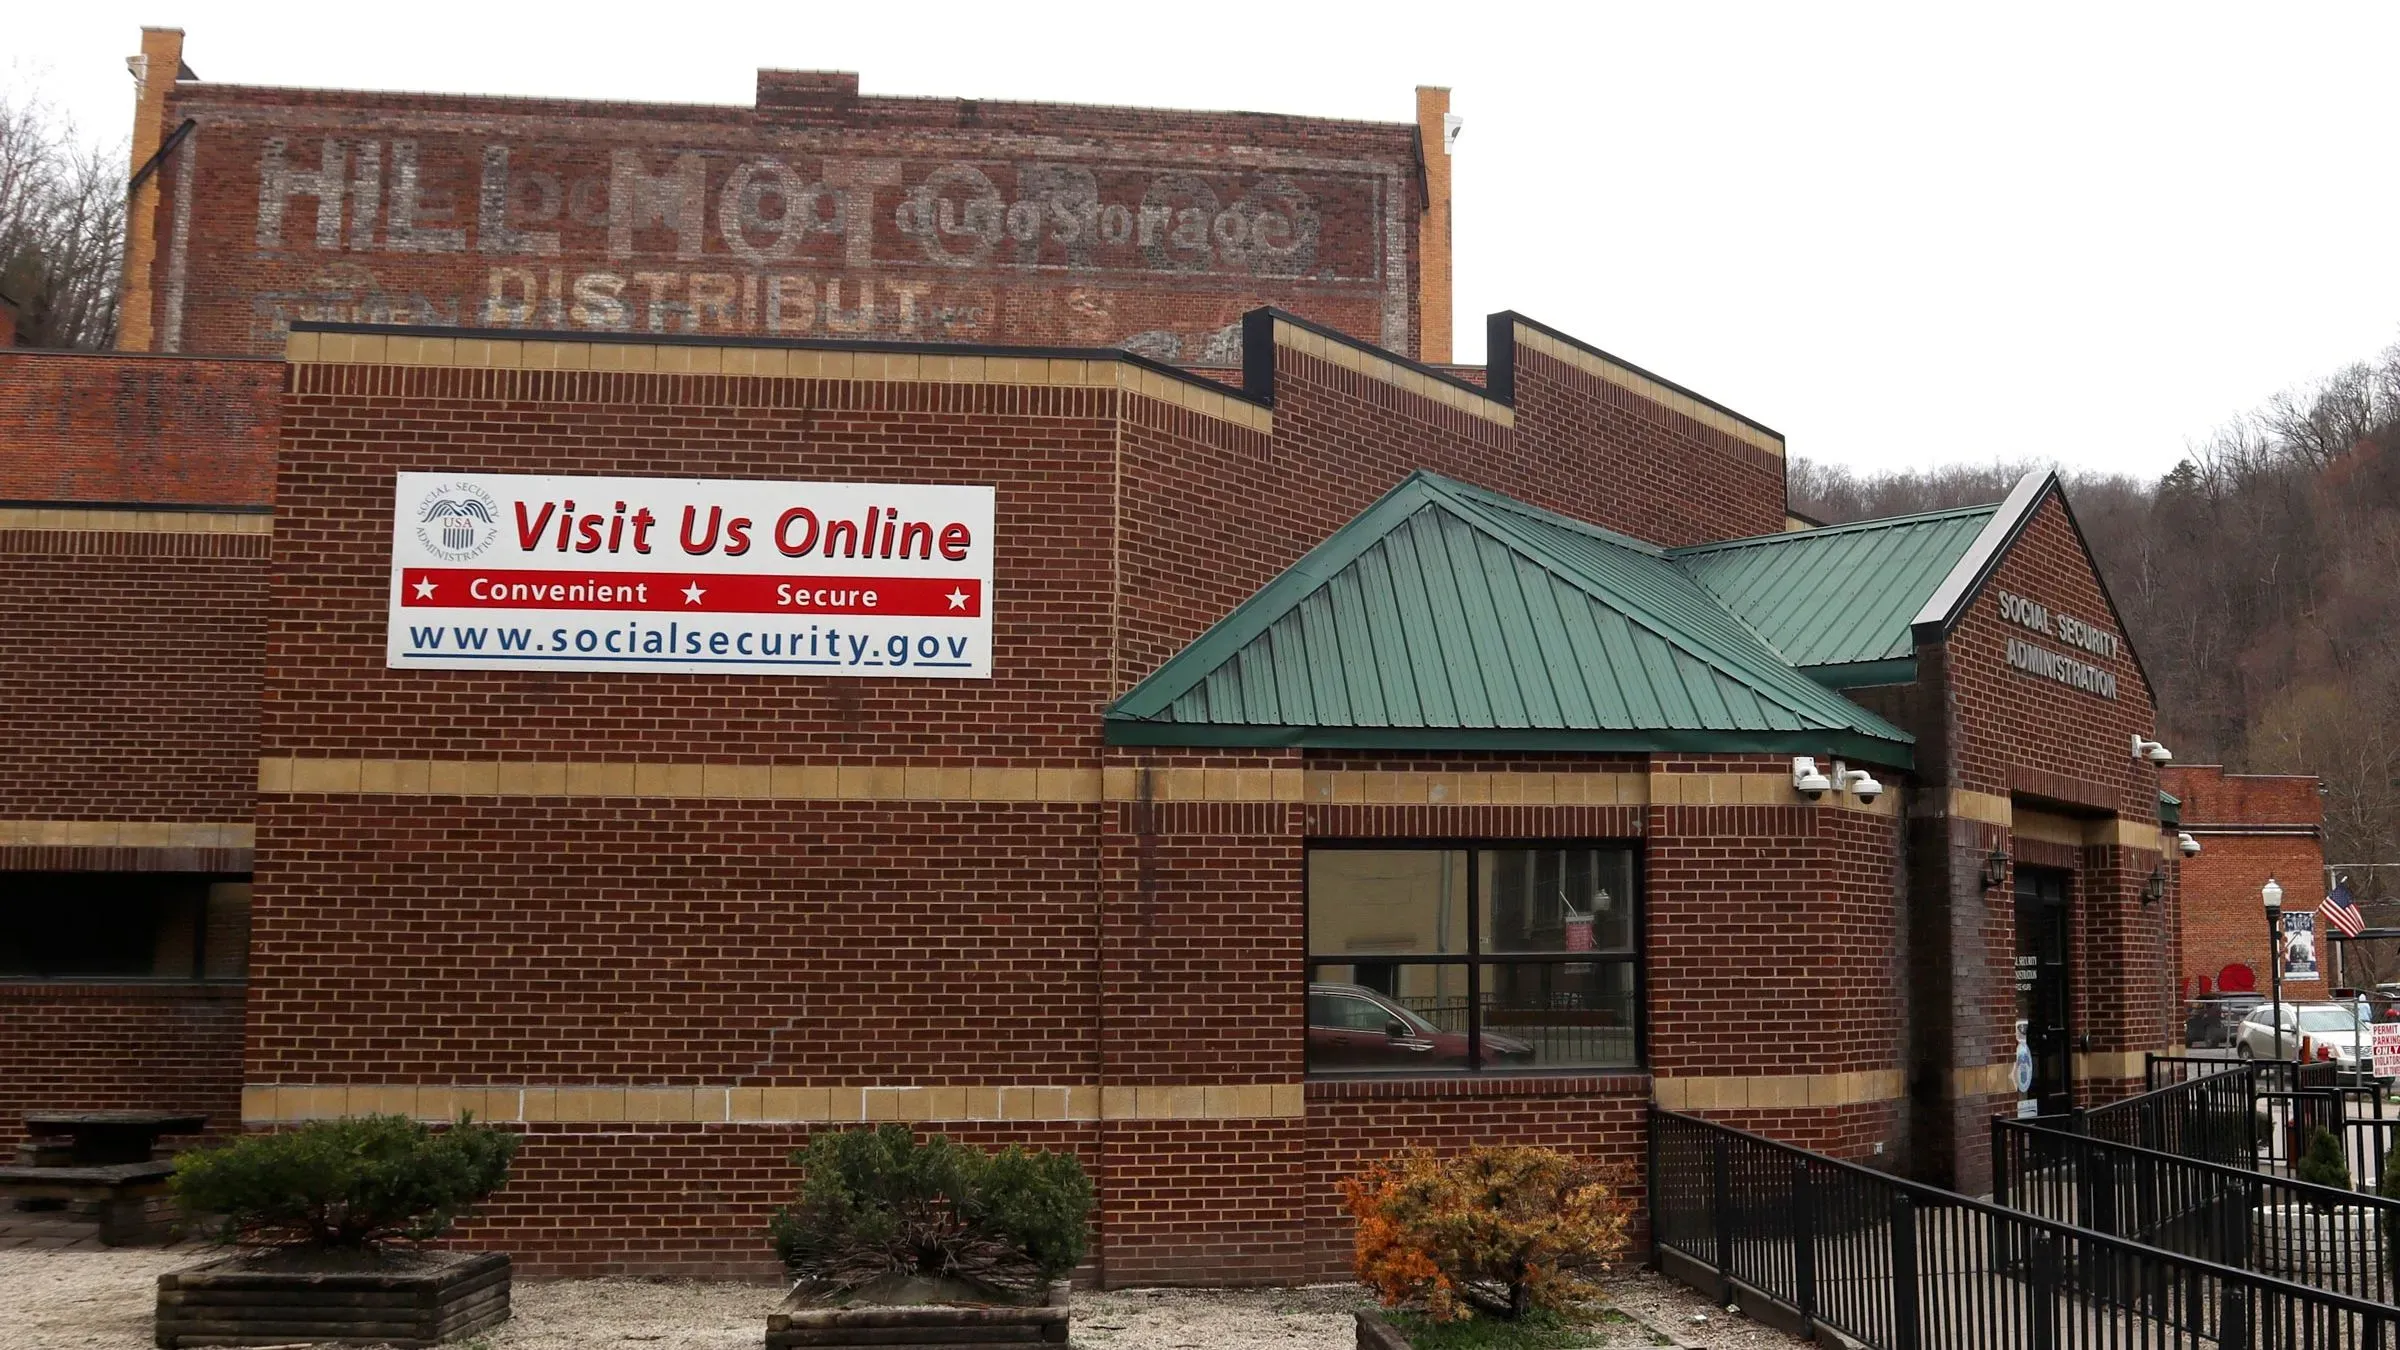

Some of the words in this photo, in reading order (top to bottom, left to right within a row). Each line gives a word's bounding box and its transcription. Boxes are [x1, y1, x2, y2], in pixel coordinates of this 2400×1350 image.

[417, 484, 450, 516] SOCIAL
[456, 482, 500, 518] SECURITY
[443, 517, 472, 528] USA
[514, 500, 656, 555] Visit
[679, 505, 753, 557] Us
[774, 506, 971, 561] Online
[416, 526, 498, 562] ADMINISTRATION
[469, 578, 648, 603] Convenient
[776, 583, 878, 608] Secure
[1999, 590, 2053, 635] SOCIAL
[2057, 614, 2118, 660] SECURITY
[410, 621, 969, 666] www.socialsecurity.gov
[2007, 638, 2118, 700] ADMINISTRATION
[2373, 1024, 2398, 1035] PERMIT
[2376, 1045, 2399, 1056] ONLY
